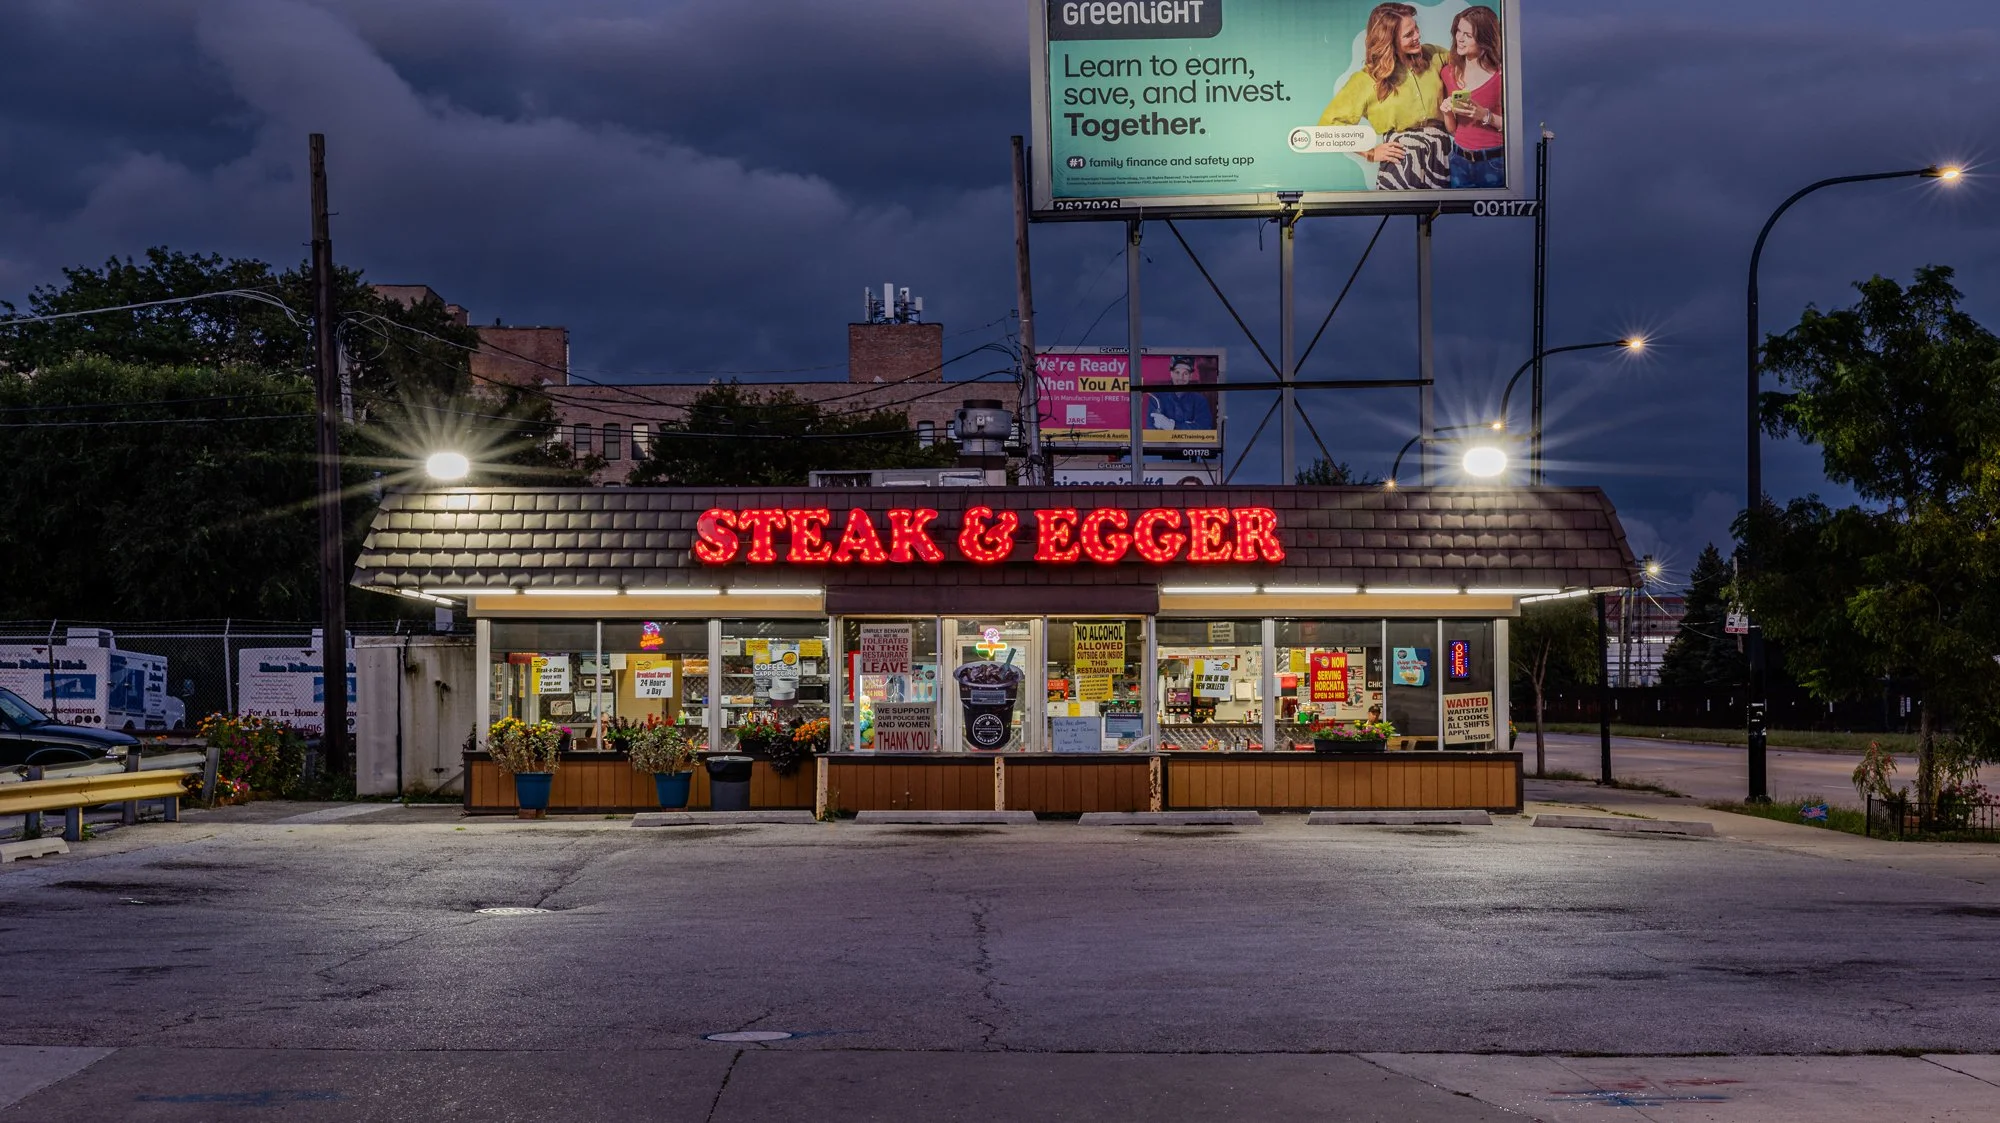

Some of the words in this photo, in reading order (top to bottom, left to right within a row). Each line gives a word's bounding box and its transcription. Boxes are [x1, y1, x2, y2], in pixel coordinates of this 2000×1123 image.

[1064, 54, 1142, 77] Learn
[1149, 55, 1178, 77] to
[1185, 56, 1256, 80] earn,
[1063, 87, 1135, 109] save,
[1142, 79, 1196, 104] and
[1205, 78, 1291, 103] invest.
[1063, 112, 1206, 141] Together.
[1341, 131, 1365, 140] saving
[1330, 139, 1356, 148] laptop
[1069, 158, 1084, 167] #1
[1089, 156, 1124, 169] family
[1126, 156, 1167, 167] finance
[1170, 156, 1192, 167] and
[1194, 156, 1229, 168] safety
[1232, 156, 1255, 167] app
[1473, 201, 1538, 216] 001177
[1036, 357, 1075, 371] We're
[1080, 357, 1126, 375] Ready
[1080, 378, 1106, 391] You
[1111, 378, 1130, 391] Ar
[695, 506, 944, 563] STEAK
[959, 506, 1018, 563] &
[1034, 506, 1285, 563] EGGER
[1076, 625, 1088, 641] NO
[1090, 625, 1123, 641] ALCOHOL
[1077, 642, 1123, 651] ALLOWED
[1077, 651, 1098, 660] OUTSIDE
[1099, 651, 1107, 660] OR
[1108, 651, 1124, 660] INSIDE
[1455, 643, 1464, 675] OPEN
[862, 662, 909, 673] LEAVE
[1331, 657, 1346, 669] NOW
[1317, 671, 1342, 681] SERVING
[651, 688, 662, 696] Day
[1206, 683, 1226, 691] SKILLETS
[1314, 681, 1345, 691] HORCHATA
[1446, 697, 1489, 709] WANTED
[248, 708, 263, 717] For
[265, 708, 277, 717] An
[280, 708, 318, 717] In-Home
[1447, 707, 1489, 715] WAITSTAFF
[1448, 722, 1462, 730] ALL
[1464, 720, 1490, 728] SHIFTS
[878, 732, 909, 751] THANK
[911, 732, 931, 751] YOU
